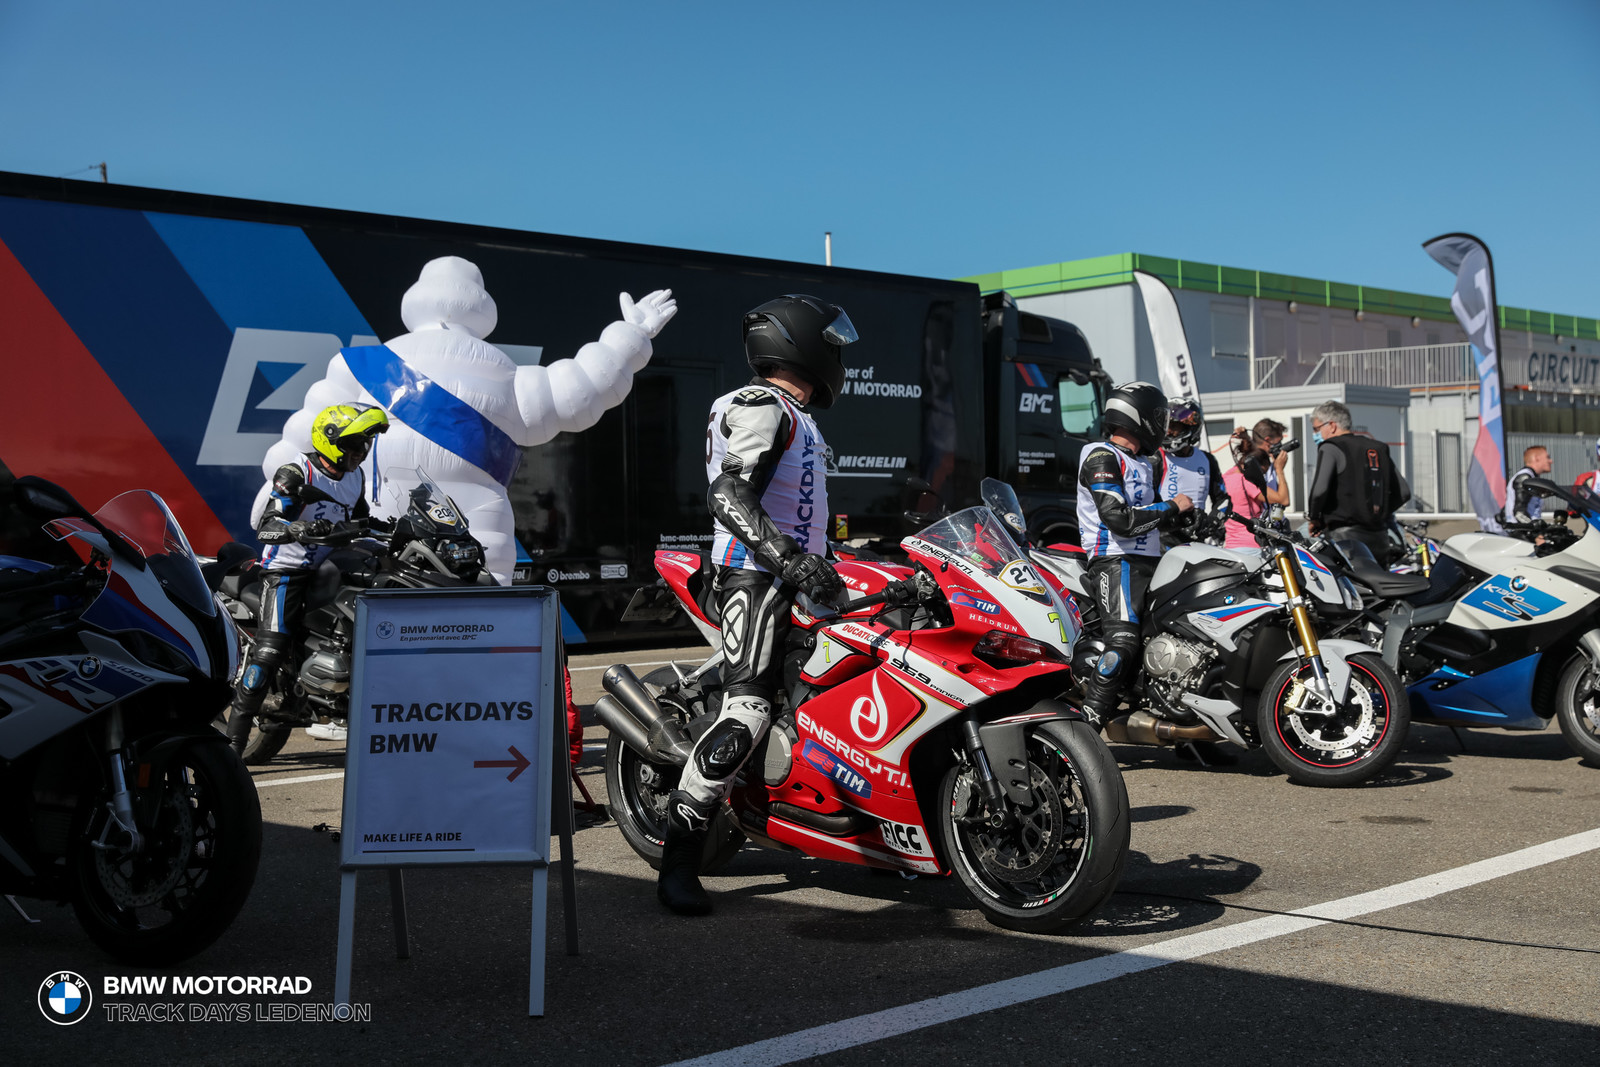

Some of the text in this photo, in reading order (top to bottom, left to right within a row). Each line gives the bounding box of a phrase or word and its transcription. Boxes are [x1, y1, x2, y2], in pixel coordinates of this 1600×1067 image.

[861, 366, 874, 380] of
[1528, 352, 1600, 385] CIRCUIT
[853, 381, 922, 398] MOTORRAD
[1019, 392, 1054, 414] BMC
[837, 455, 907, 469] MICHELIN
[1168, 463, 1178, 500] KDAYS
[792, 434, 817, 553] RACKDAYS
[713, 493, 760, 541] IXON
[559, 570, 590, 581] brembo
[976, 600, 996, 613] TIM
[400, 624, 495, 634] BMW MOTORRAD
[969, 613, 1018, 633] HEIDRUN
[409, 634, 445, 642] partenariat
[108, 660, 154, 683] S1000
[890, 657, 931, 685] 959
[371, 701, 533, 723] TRACKDAYS
[369, 733, 438, 754] BMW
[834, 763, 866, 792] TIM
[363, 832, 462, 843] MAKE LIFE A RIDE
